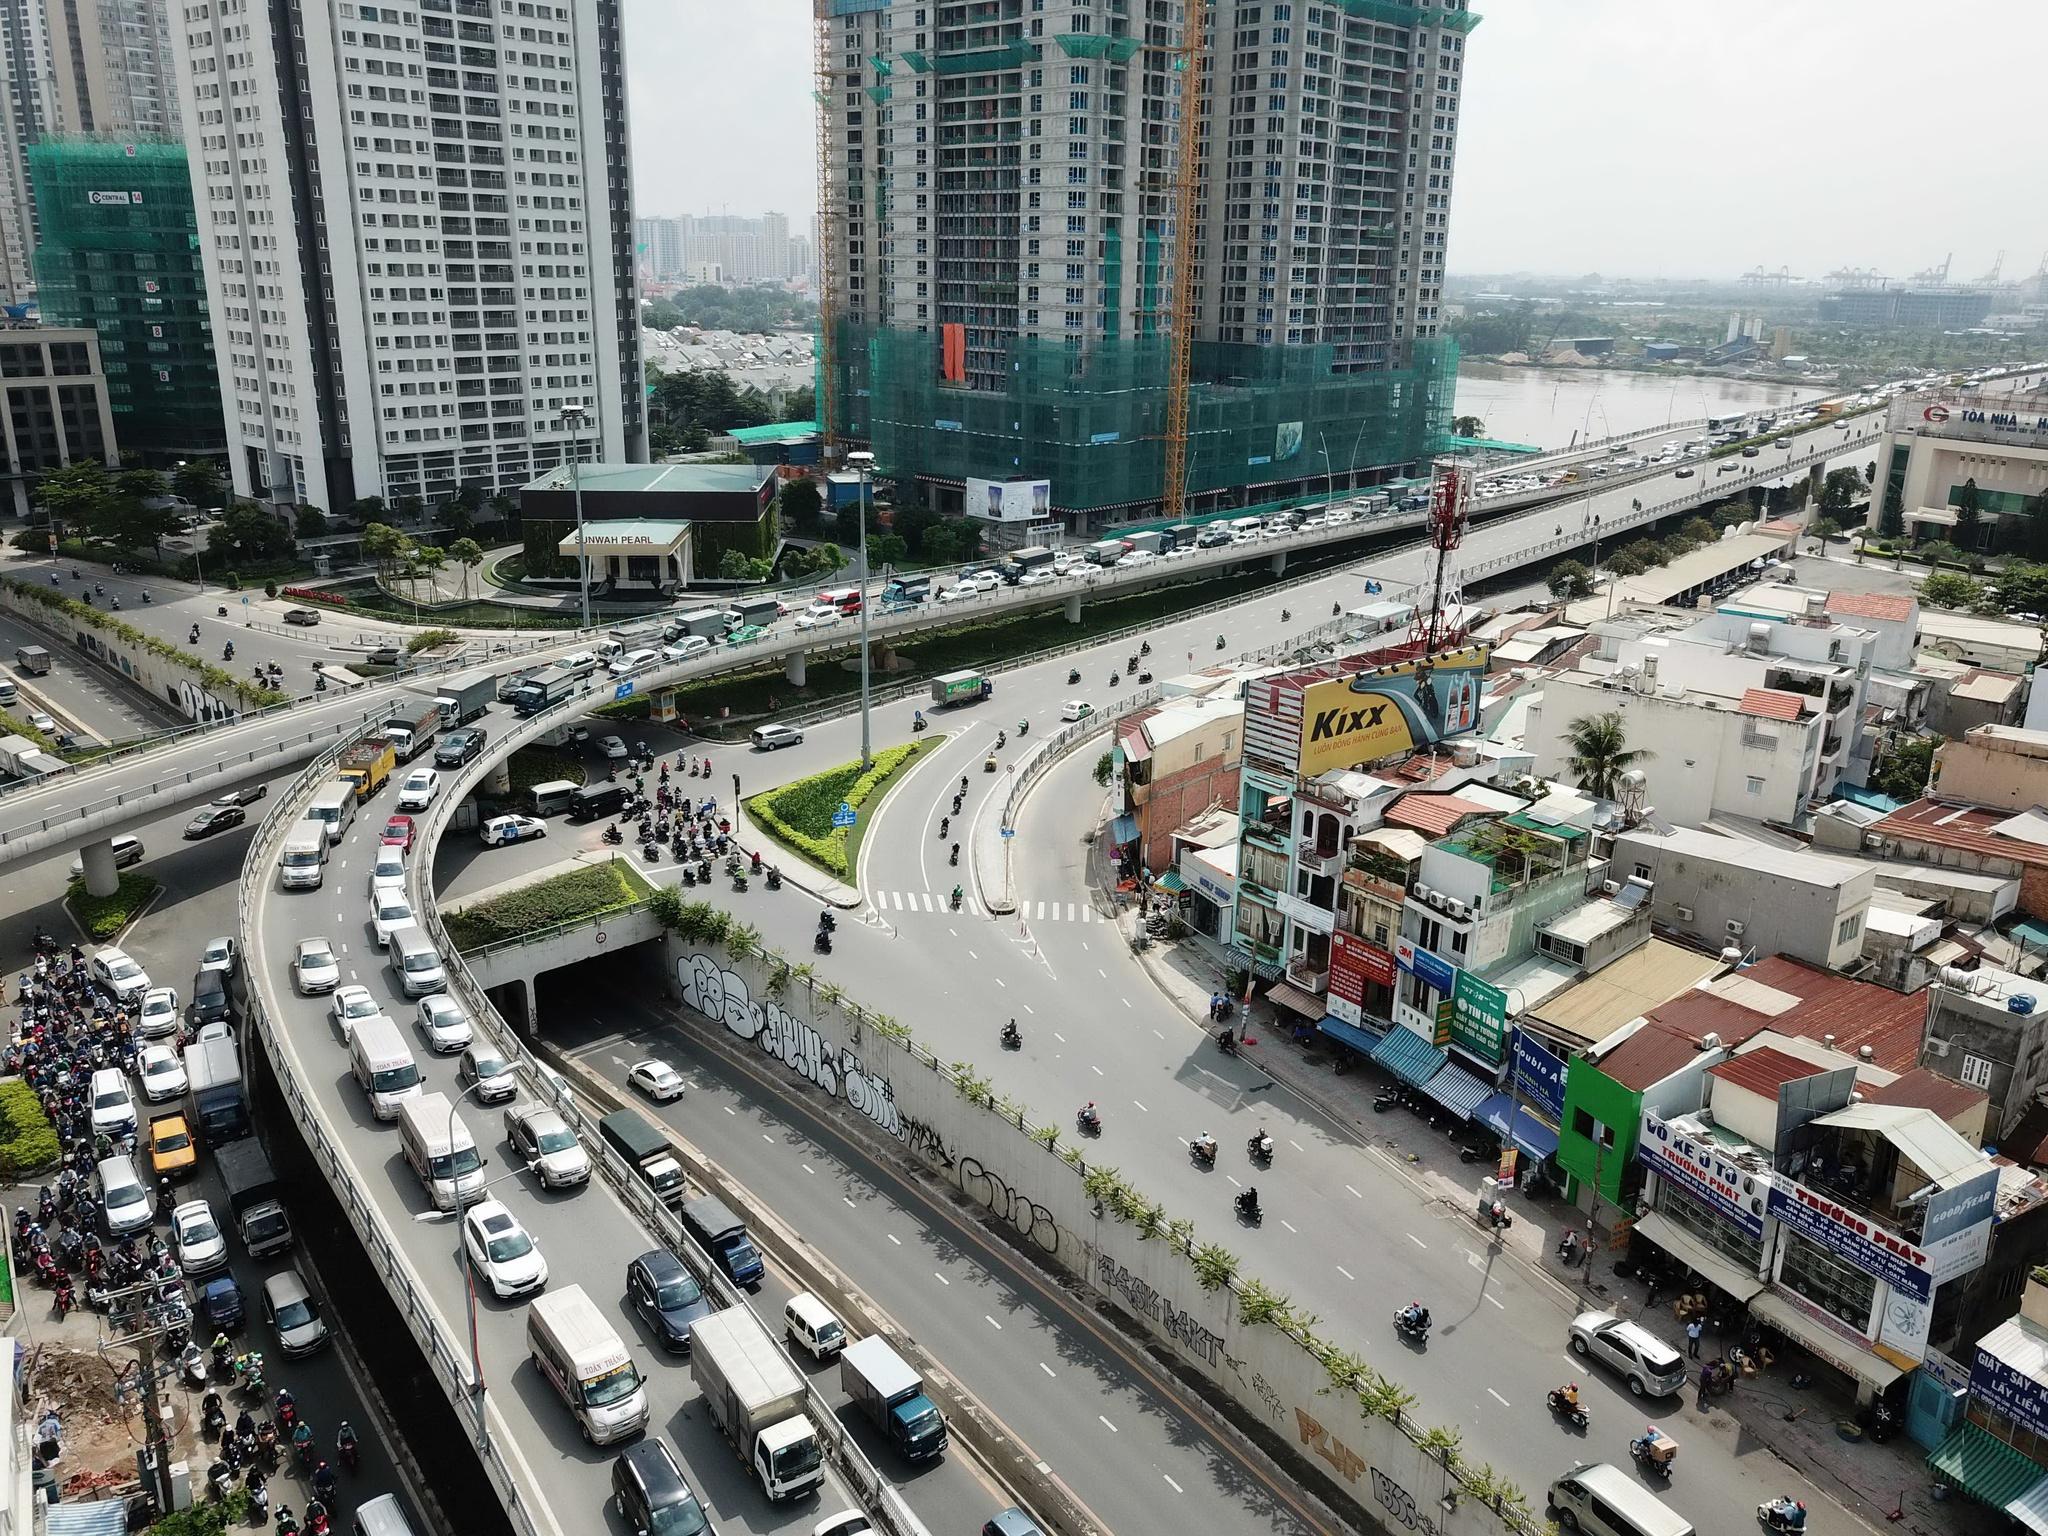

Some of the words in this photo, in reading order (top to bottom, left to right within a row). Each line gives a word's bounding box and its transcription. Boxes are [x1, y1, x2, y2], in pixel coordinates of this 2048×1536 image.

[127, 146, 134, 155] 16
[133, 193, 141, 202] 14
[146, 283, 154, 291] 10
[155, 328, 160, 336] 8
[161, 372, 166, 380] 6
[1962, 408, 1985, 424] TÒA
[622, 536, 653, 544] PEARL
[1314, 742, 1332, 755] LUÔN
[1352, 733, 1371, 744] HÀNH
[1372, 729, 1389, 739] CÙNG
[1399, 946, 1412, 959] 3M
[1513, 1042, 1546, 1074] Double
[1550, 1073, 1557, 1083] A
[1647, 1118, 1667, 1141] VỎ
[1709, 1176, 1741, 1202] PHÁT
[1933, 1191, 1992, 1223] GOODYEAR
[1773, 1205, 1796, 1220] CHUYÊN
[1871, 1260, 1883, 1270] CÁC
[1862, 1248, 1875, 1258] MÁY
[1873, 1230, 1926, 1266] PHÁT
[585, 1363, 601, 1374] TOÀN
[1926, 1359, 1945, 1379] TM
[1978, 1352, 2001, 1374] GIẶT
